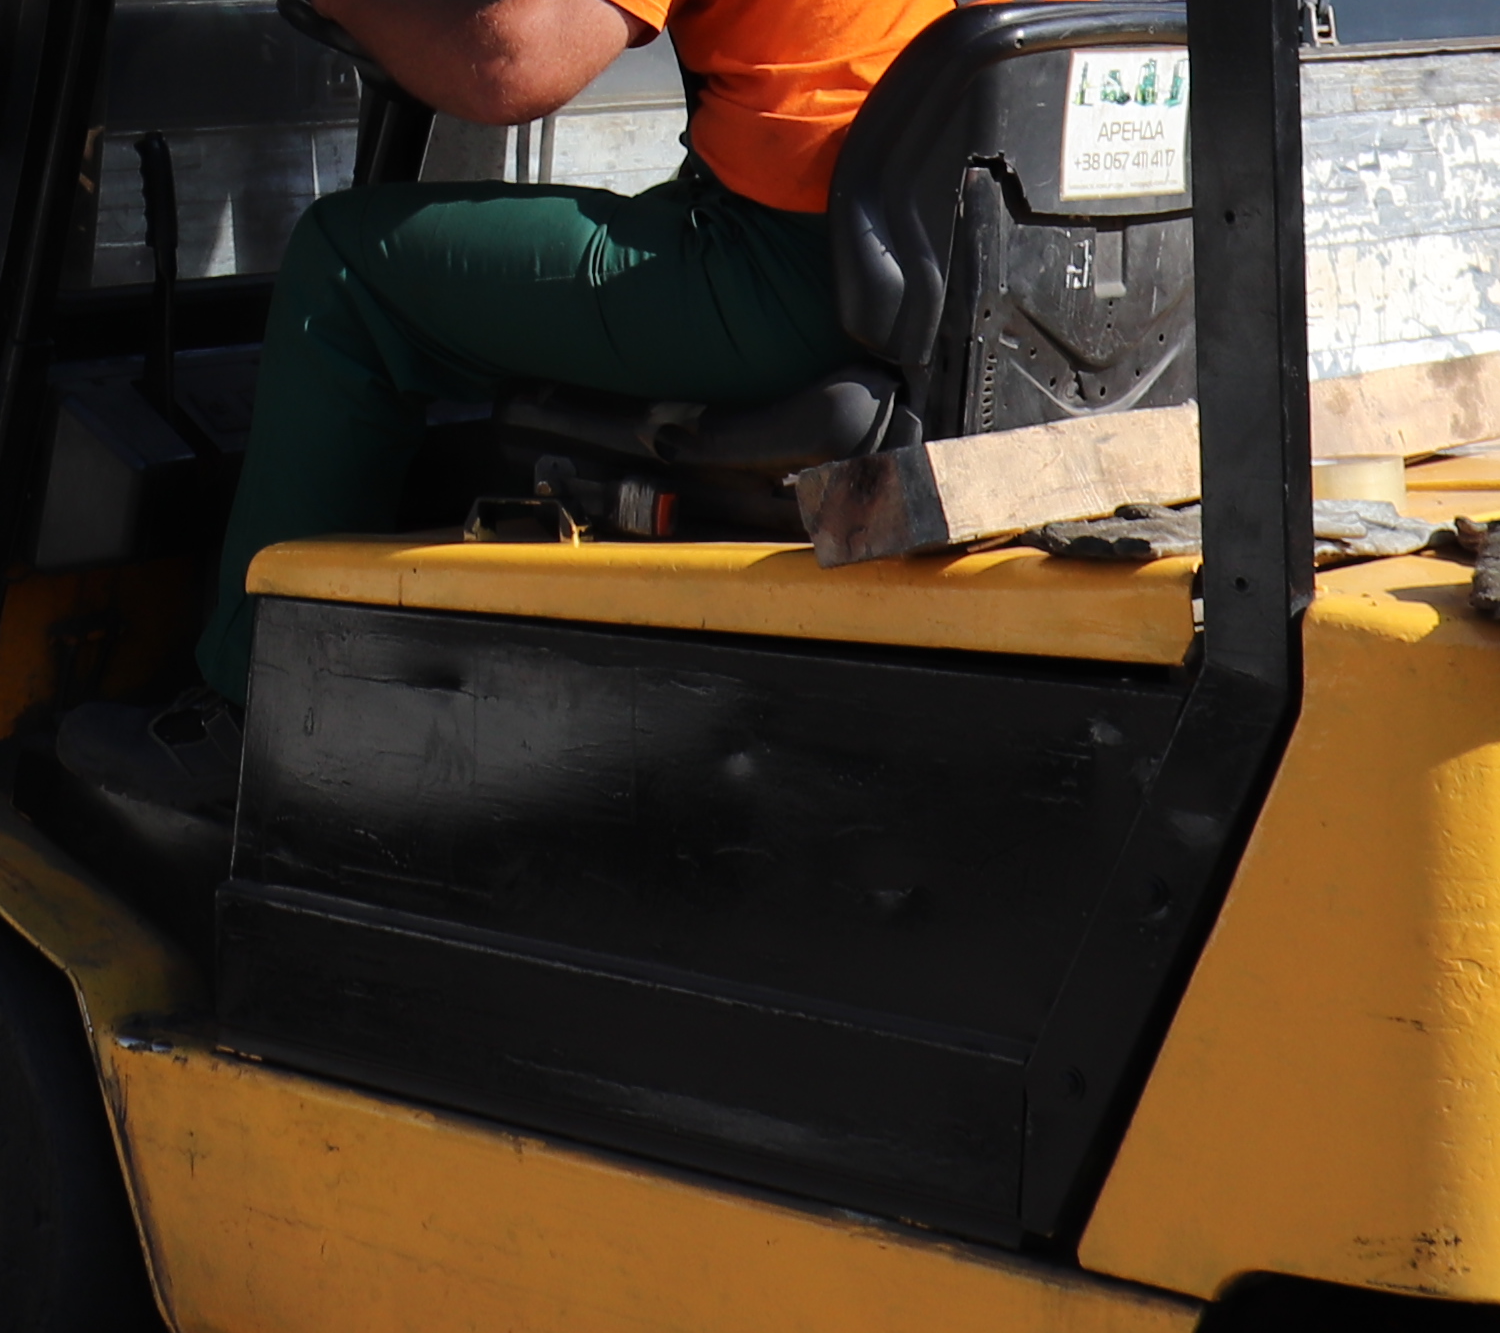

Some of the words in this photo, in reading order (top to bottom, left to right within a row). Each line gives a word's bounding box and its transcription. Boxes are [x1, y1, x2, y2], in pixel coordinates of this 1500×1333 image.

[1097, 120, 1164, 142] АРЕНДА
[1074, 152, 1101, 171] +38
[1103, 151, 1130, 170] 067
